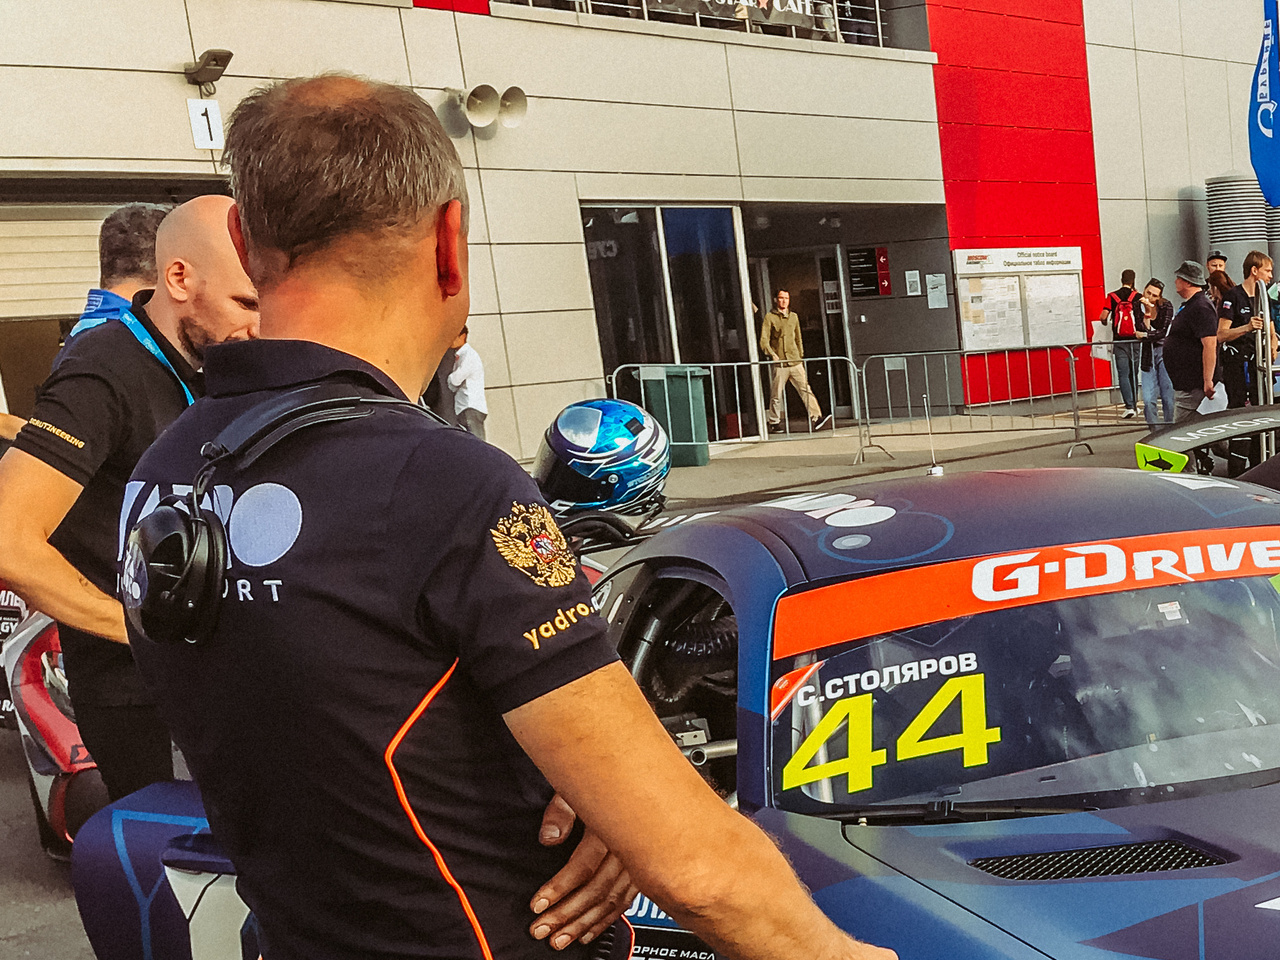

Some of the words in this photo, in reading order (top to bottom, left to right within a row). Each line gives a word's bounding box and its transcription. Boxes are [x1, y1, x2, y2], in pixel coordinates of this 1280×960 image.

[200, 107, 214, 142] 1
[28, 417, 86, 449] SCRUTINEERING
[796, 652, 978, 708] С.СТОЛЯРОВ
[782, 673, 1002, 794] 44
[633, 946, 678, 957] ОРНОЕ
